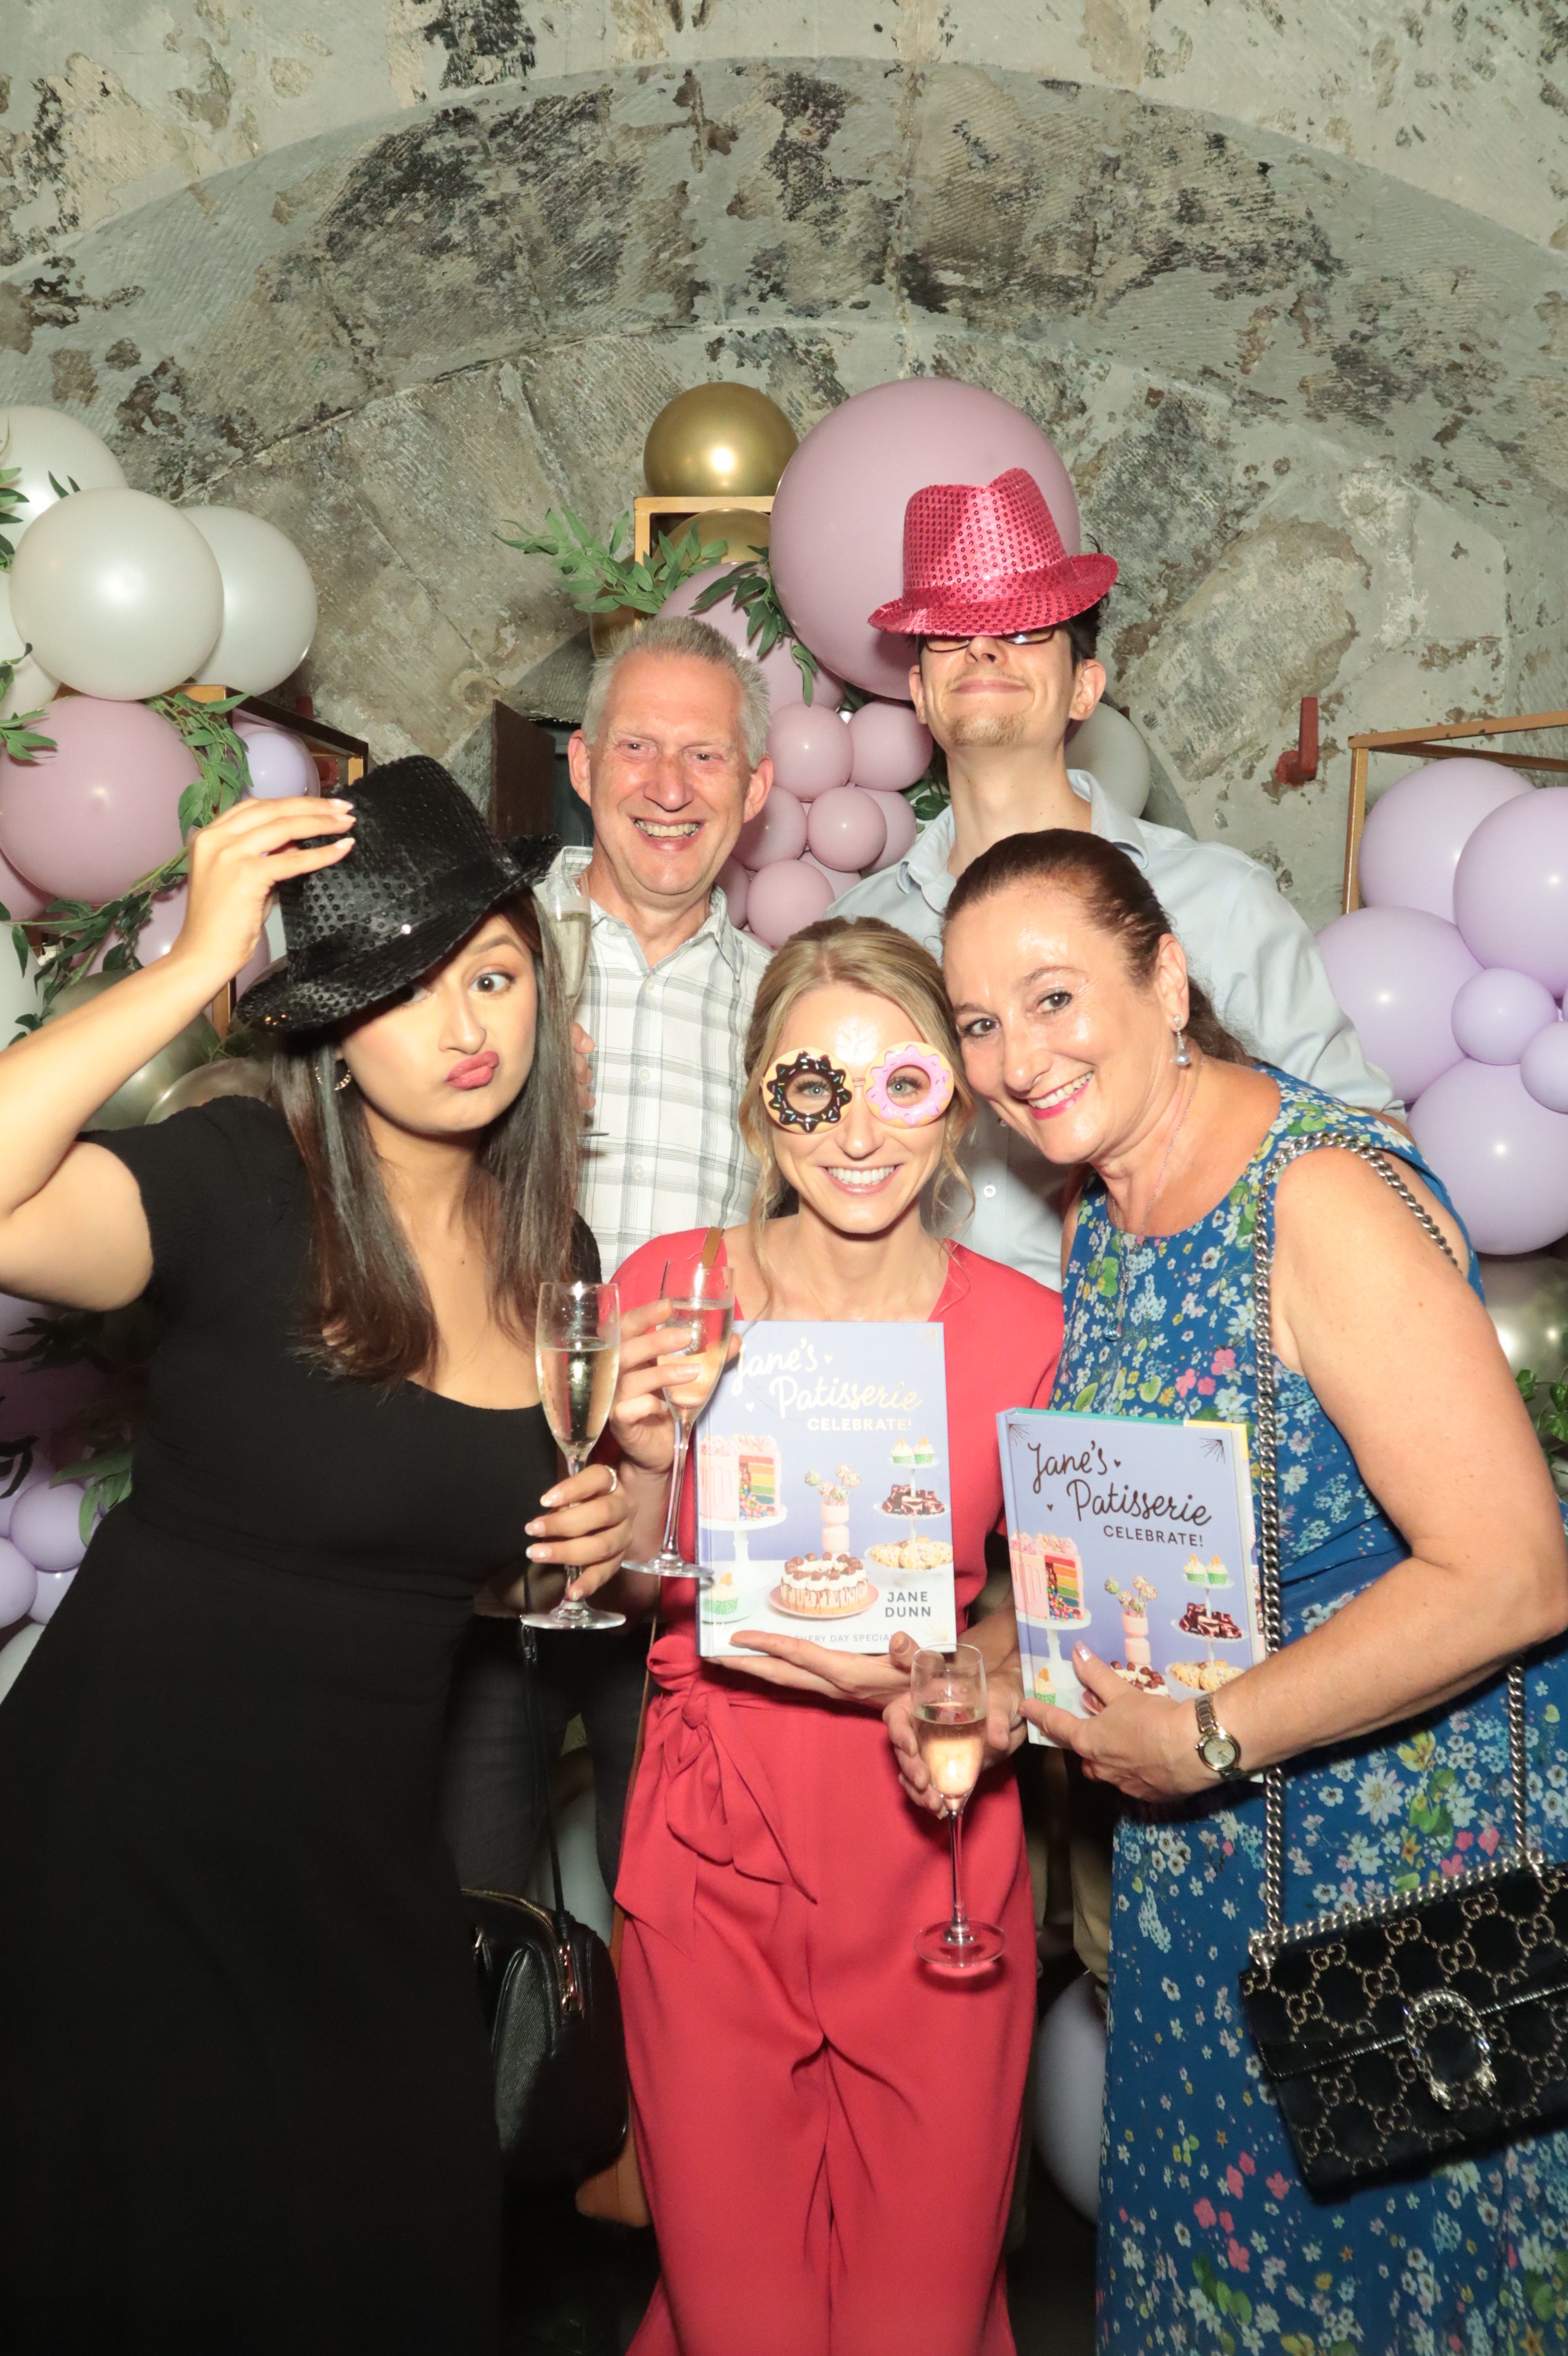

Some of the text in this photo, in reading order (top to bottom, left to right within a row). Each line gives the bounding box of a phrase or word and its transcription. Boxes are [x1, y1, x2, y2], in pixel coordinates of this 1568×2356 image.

[731, 1338, 818, 1396] Jane's
[769, 1376, 922, 1419] Patisserie
[806, 1417, 912, 1431] CELEBRATE!
[1028, 1440, 1107, 1494] Jane's
[1066, 1478, 1212, 1526] Patisserie
[1103, 1525, 1204, 1547] CELEBRATE!
[887, 1591, 928, 1603] JANE
[885, 1606, 931, 1618] DUNN
[830, 1634, 850, 1643] DAY
[853, 1633, 893, 1642] SPECIA
